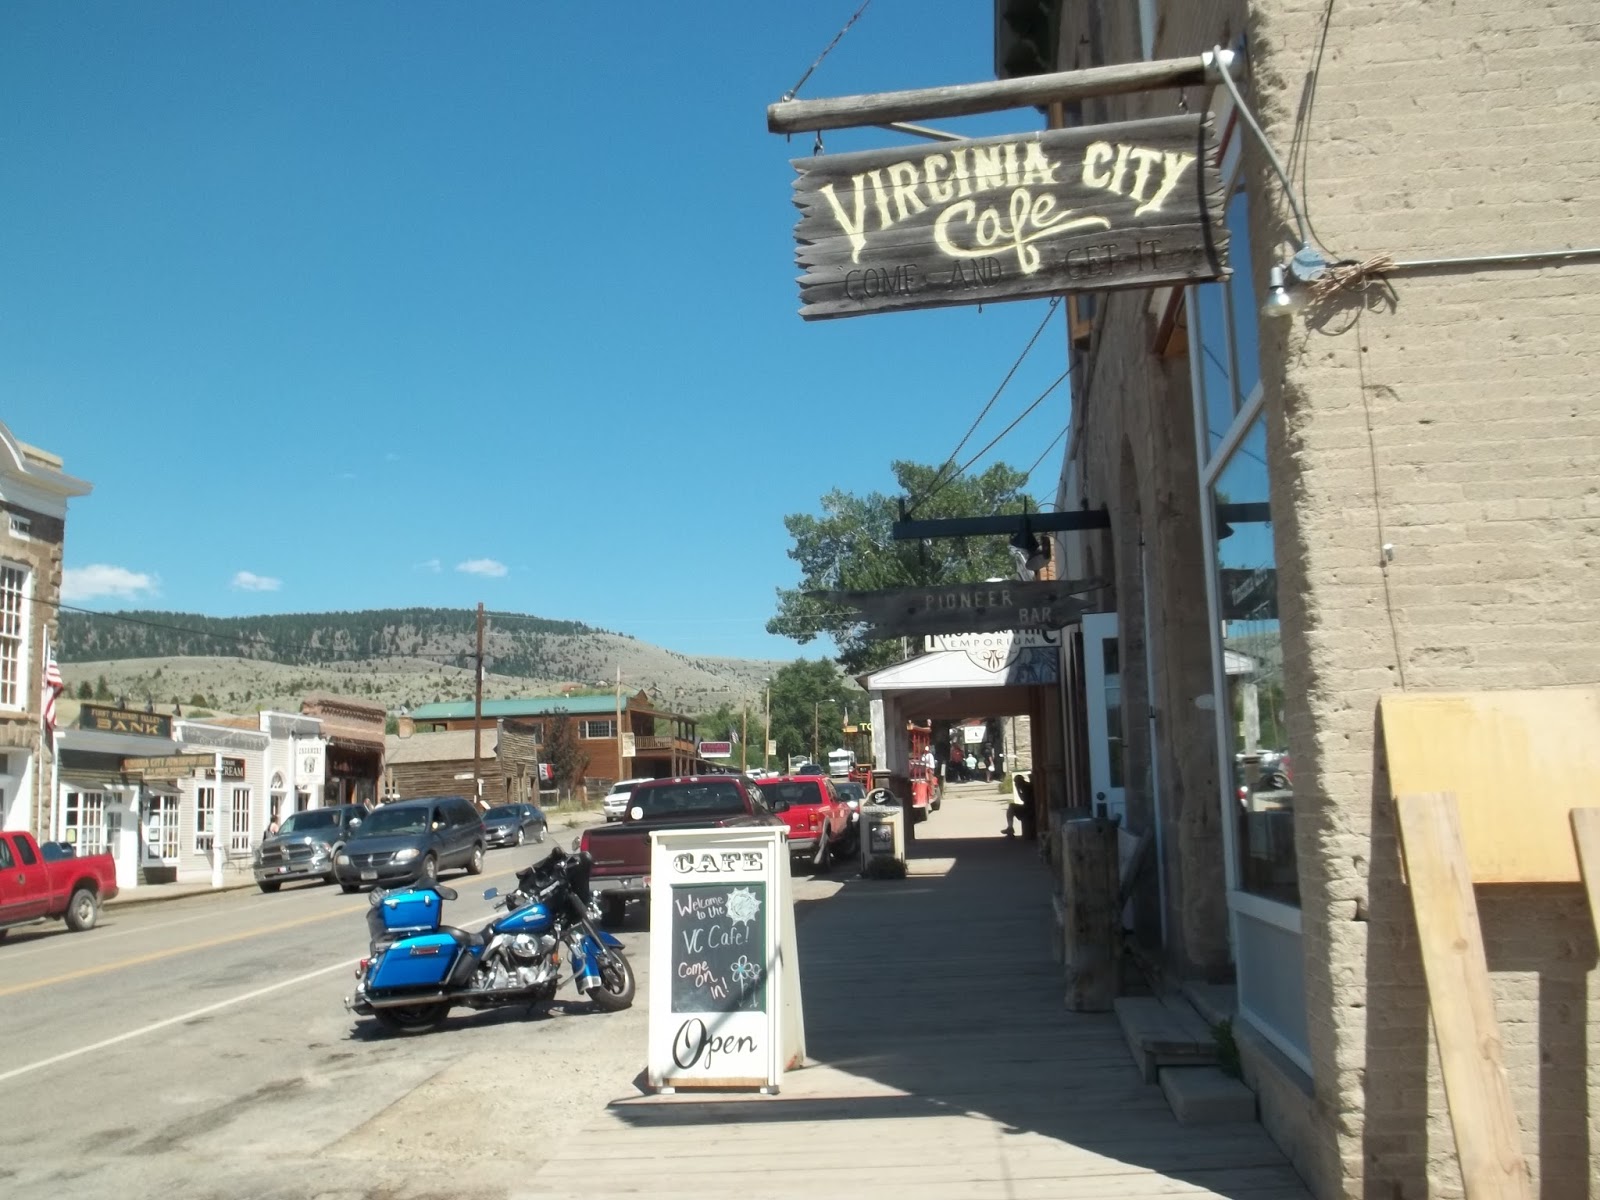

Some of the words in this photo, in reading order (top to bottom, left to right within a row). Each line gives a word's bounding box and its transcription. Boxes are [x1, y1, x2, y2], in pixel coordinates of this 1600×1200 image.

[819, 141, 1061, 264] VIRGINIA
[1082, 141, 1197, 217] CITY
[934, 188, 1112, 274] Cafe
[845, 263, 918, 300] COME
[946, 256, 1000, 292] AND
[1065, 243, 1119, 280] GET
[1136, 240, 1162, 272] IT
[925, 589, 1014, 612] PIONEER
[1018, 606, 1052, 625] BAR
[950, 637, 1036, 648] EMPORIUM
[96, 718, 158, 735] BANK
[673, 852, 763, 873] CAFE
[675, 894, 724, 917] Welcome
[696, 909, 706, 921] to
[707, 905, 725, 919] the
[682, 928, 704, 955] VC
[708, 925, 750, 949] Cafe!
[678, 961, 709, 979] Come
[695, 970, 718, 988] on
[672, 1018, 757, 1070] Open
